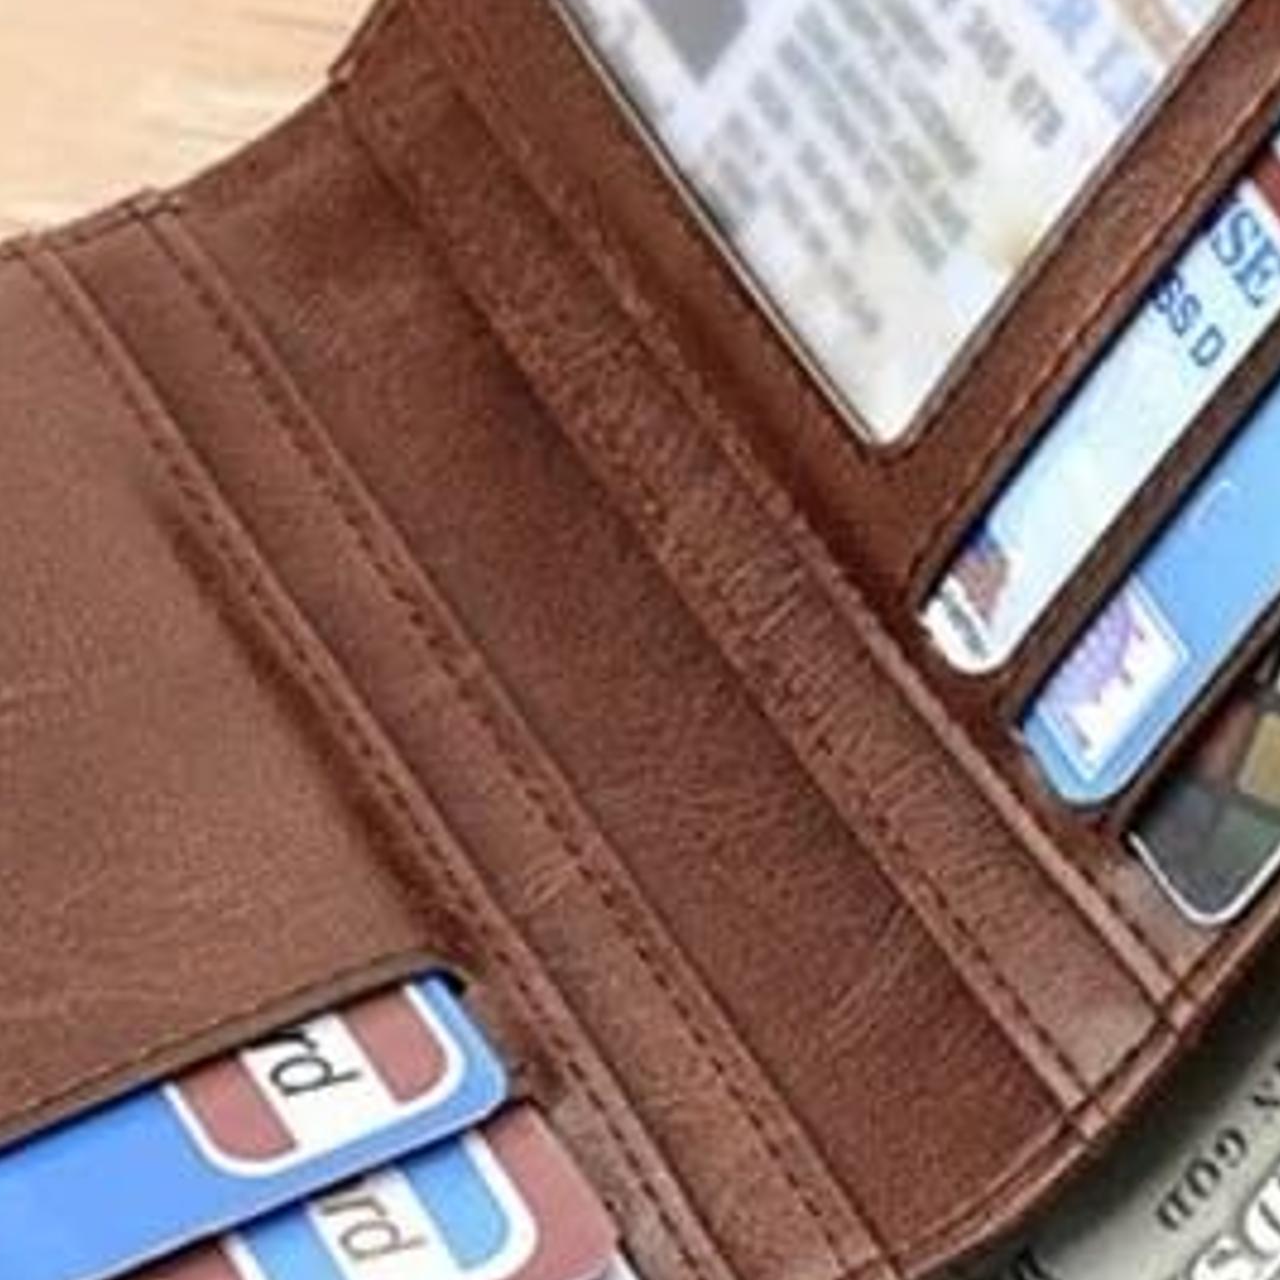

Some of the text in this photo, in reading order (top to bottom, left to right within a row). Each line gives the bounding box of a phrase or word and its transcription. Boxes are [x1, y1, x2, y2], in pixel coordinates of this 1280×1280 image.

[1189, 323, 1226, 368] D
[1155, 1126, 1248, 1232] GOD
[321, 1191, 427, 1262] rd
